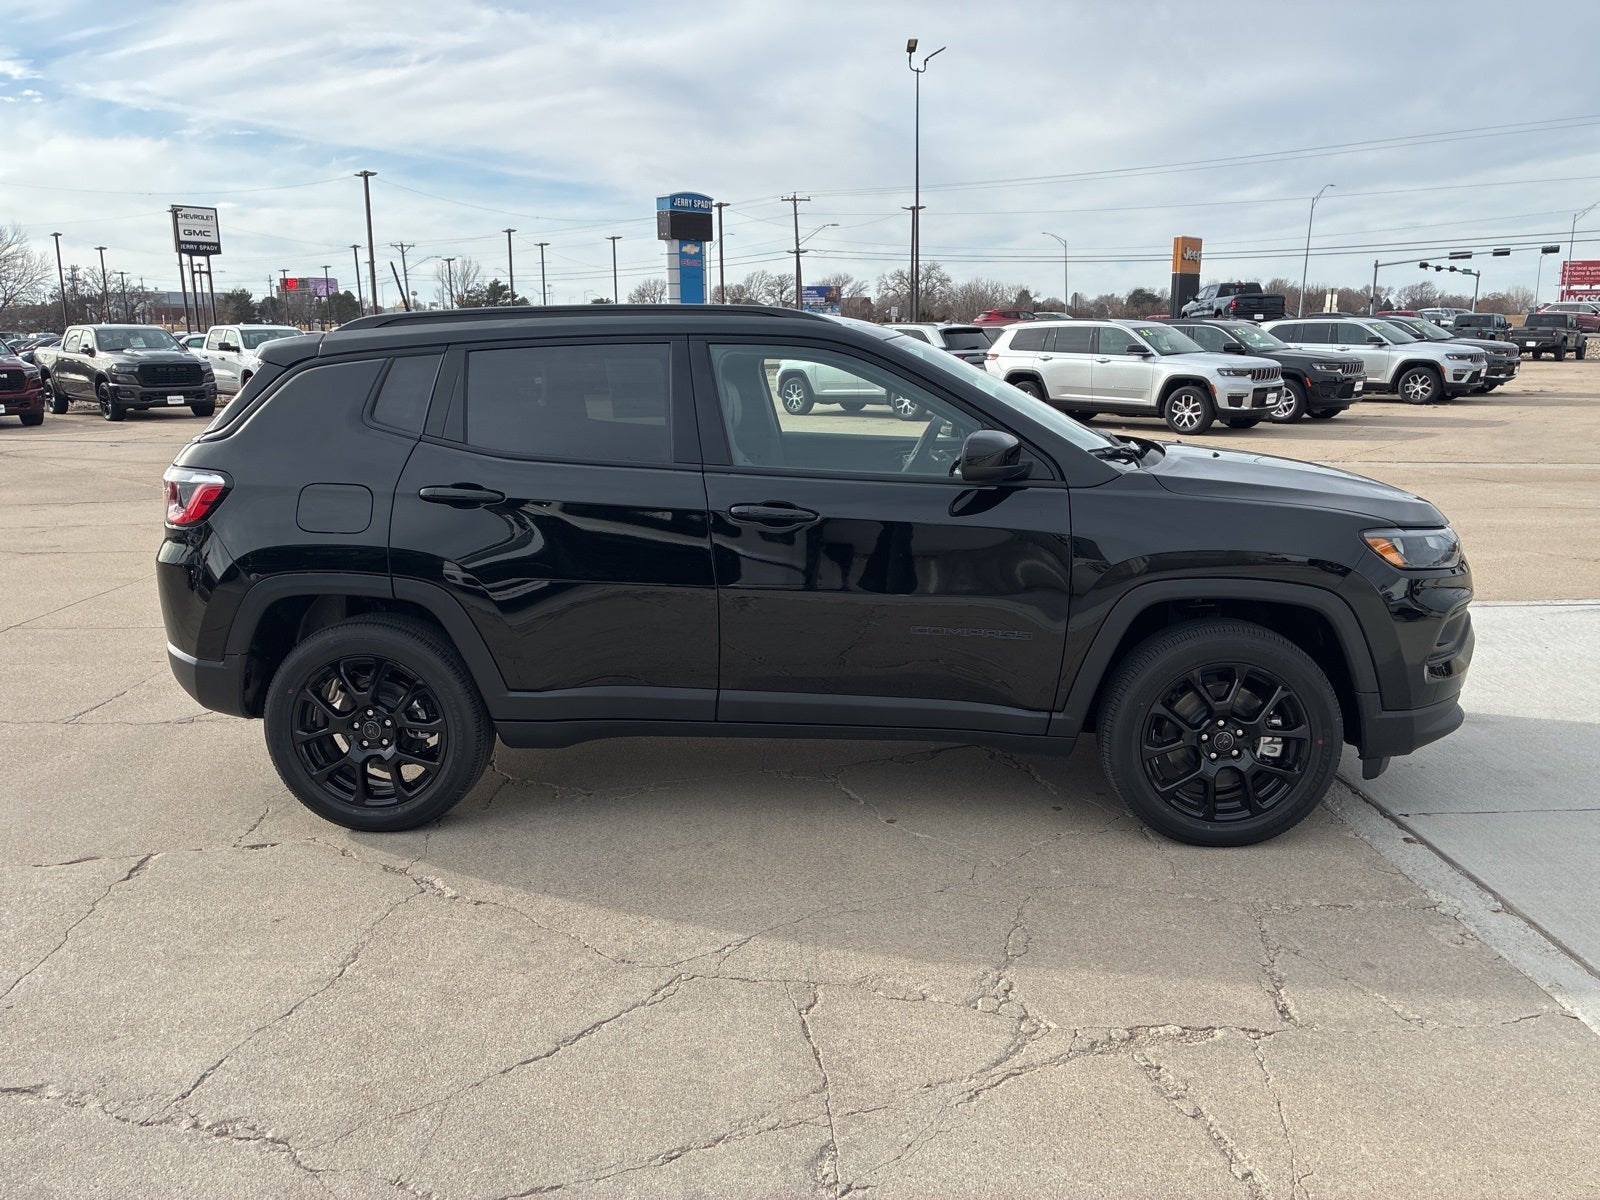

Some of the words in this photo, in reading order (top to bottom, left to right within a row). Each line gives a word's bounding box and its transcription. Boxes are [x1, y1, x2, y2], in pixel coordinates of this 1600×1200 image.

[673, 197, 692, 207] JERRY
[693, 199, 712, 209] SPADY
[177, 213, 214, 221] CHEVROLET
[183, 229, 212, 237] GMC
[1183, 246, 1201, 262] Jeep
[1140, 329, 1153, 337] 25
[910, 625, 1033, 641] COMPASS
